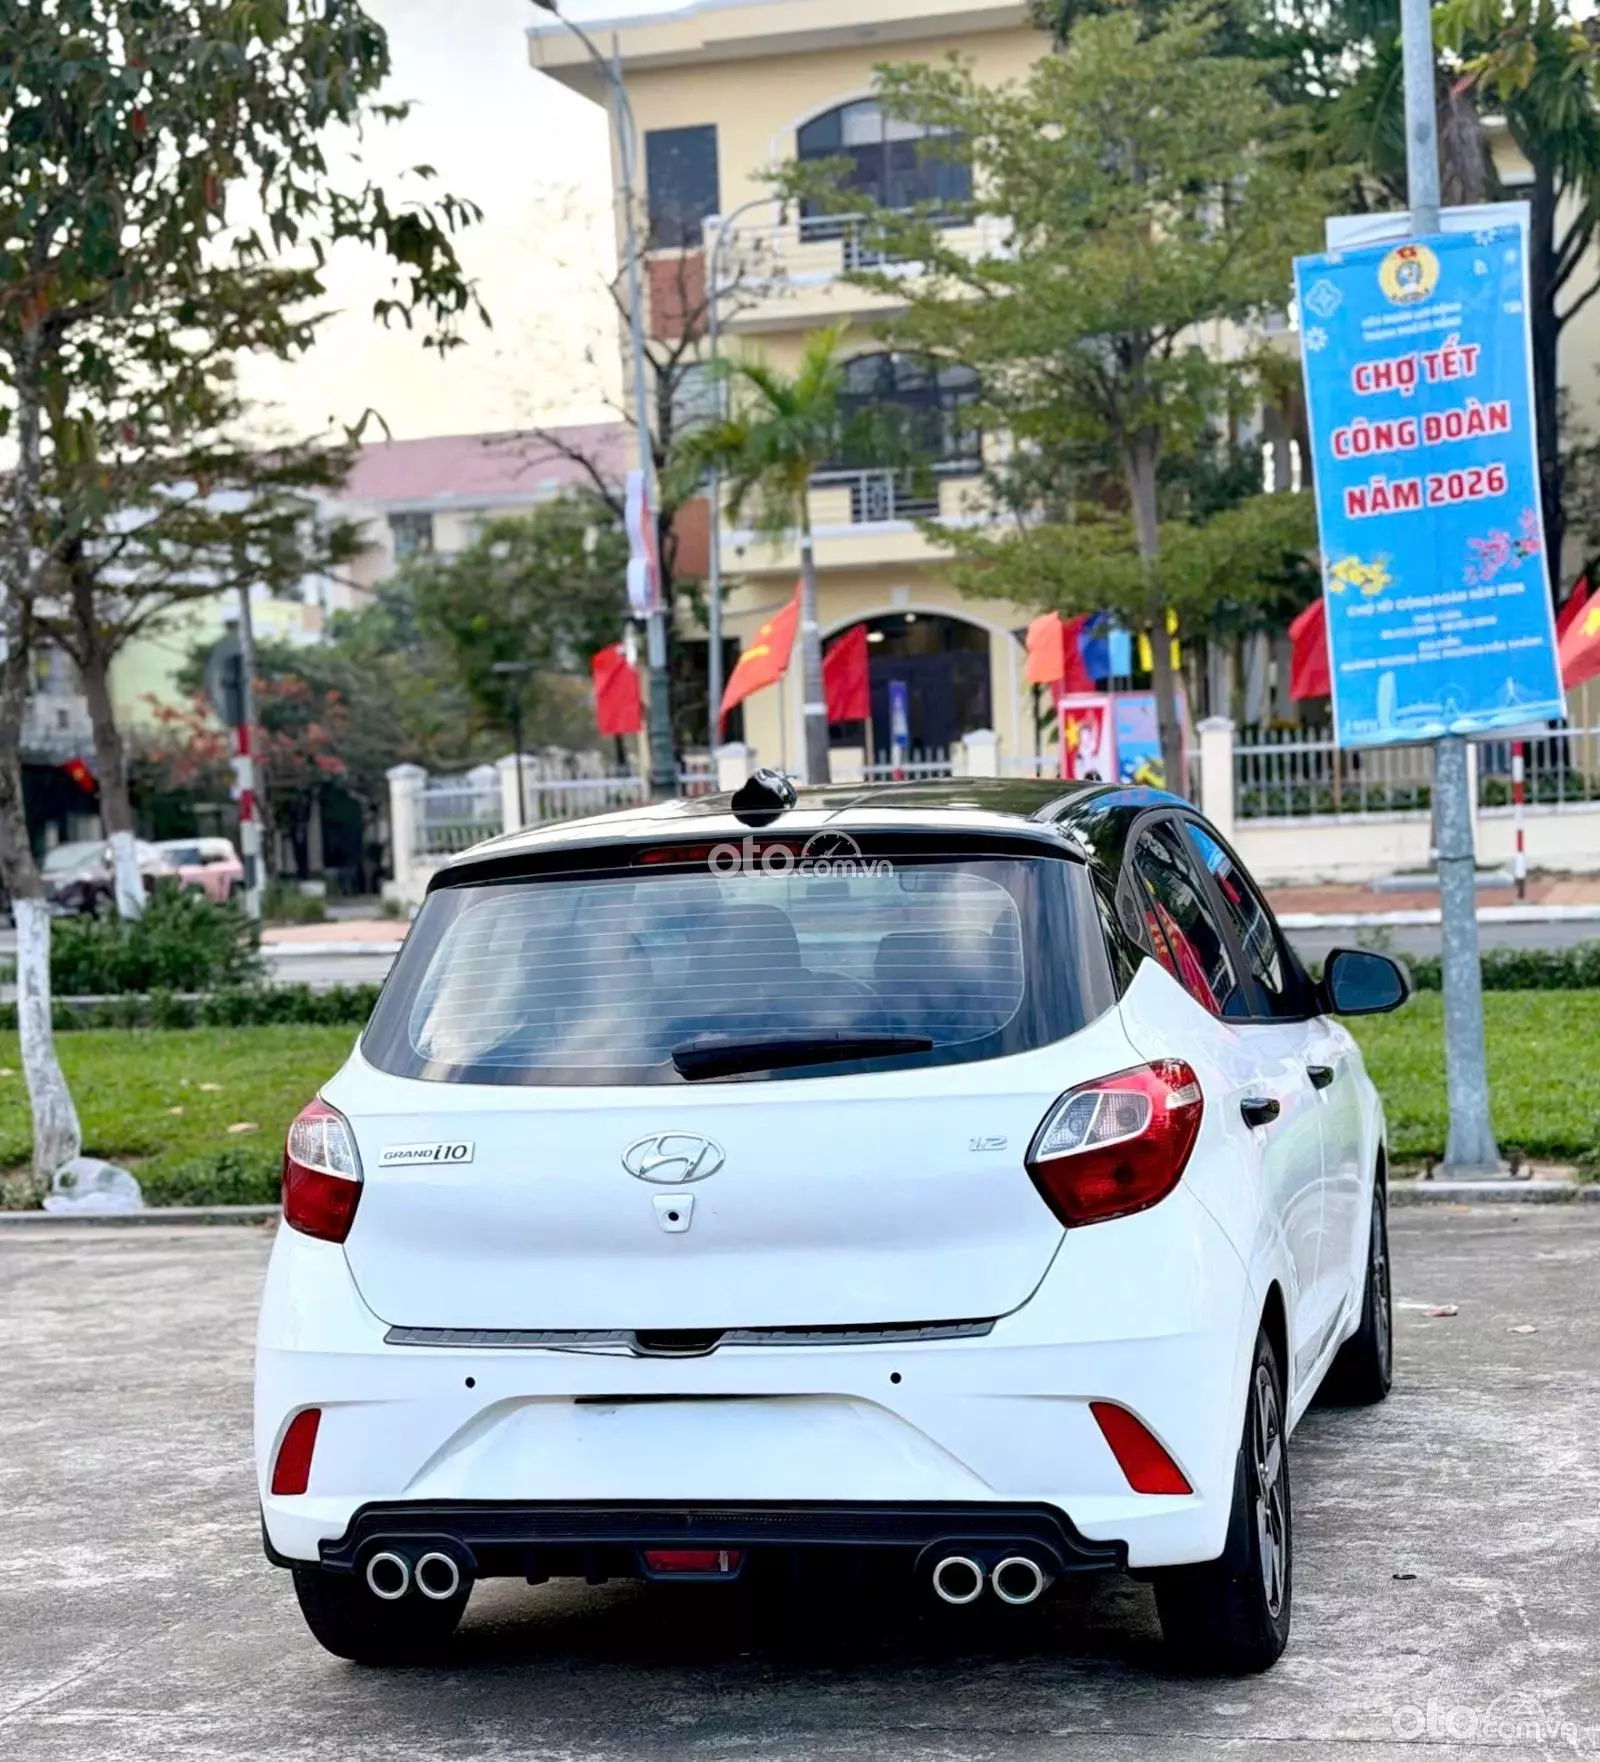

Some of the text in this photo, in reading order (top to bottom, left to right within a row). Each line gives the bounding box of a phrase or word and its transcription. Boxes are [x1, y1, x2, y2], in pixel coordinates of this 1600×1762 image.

[1354, 335, 1480, 395] CHỢ TẾT
[1332, 399, 1510, 457] CÔNG ĐOÀN
[1345, 463, 1507, 518] NĂM 2026
